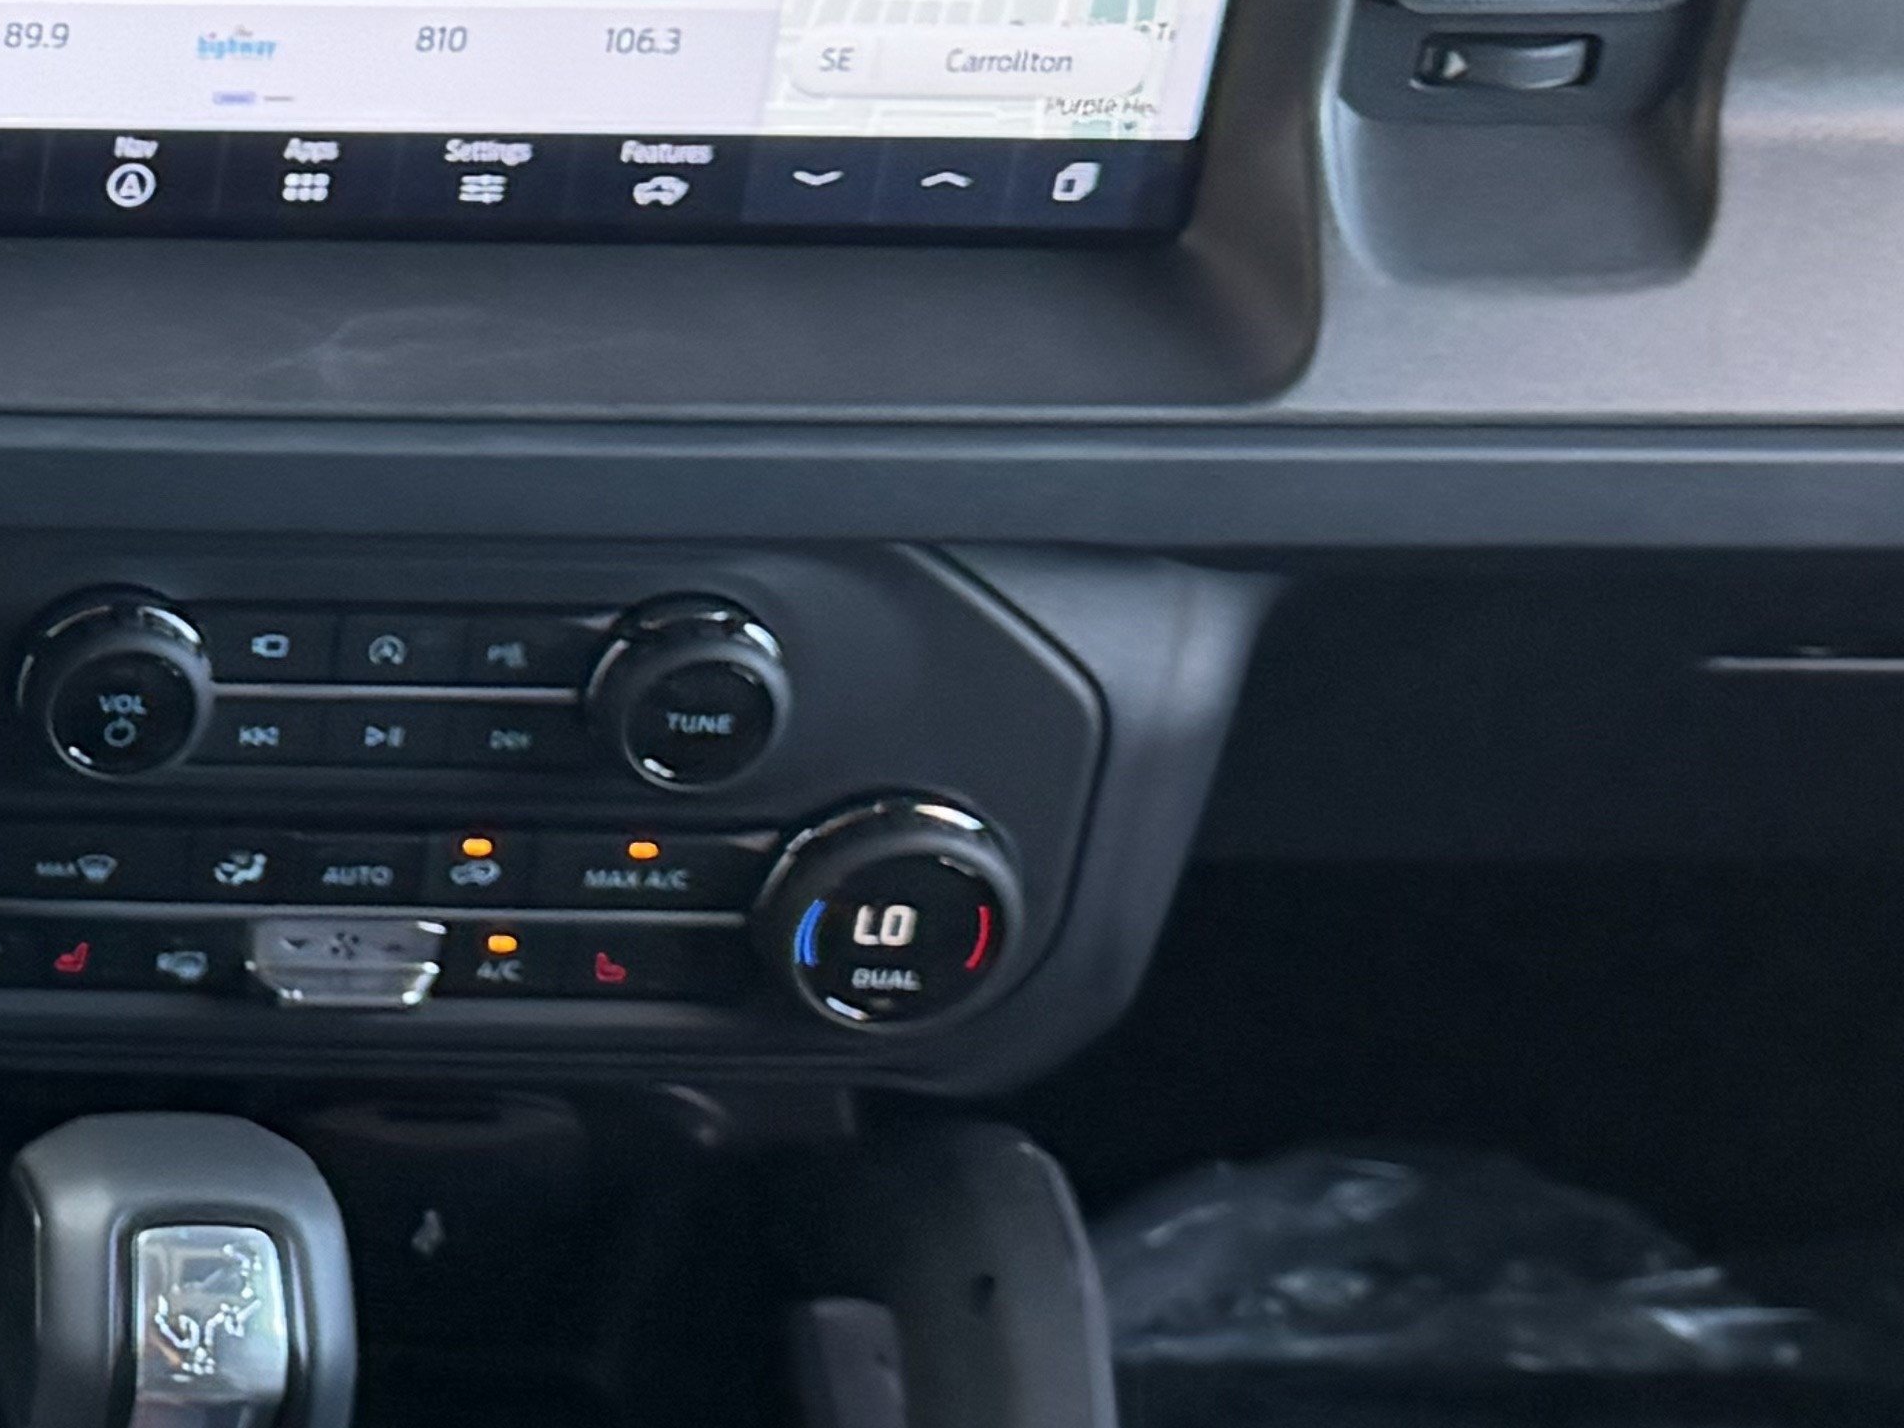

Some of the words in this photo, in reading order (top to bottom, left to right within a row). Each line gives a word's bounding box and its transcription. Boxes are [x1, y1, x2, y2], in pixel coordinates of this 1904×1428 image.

[3, 22, 70, 51] 89.9
[415, 25, 469, 54] 810
[603, 26, 683, 56] 106.3
[819, 46, 855, 73] SE
[944, 47, 1074, 75] Carrollton
[115, 135, 160, 160] Nav
[283, 137, 340, 165] Apps
[445, 138, 534, 169] Settings
[620, 140, 714, 166] Features
[99, 693, 150, 716] VOL
[666, 711, 734, 736] TUNE
[321, 865, 391, 887] AUTO
[583, 868, 640, 890] MAX
[643, 868, 691, 892] A/C
[853, 903, 918, 948] LO
[851, 967, 922, 992] DUAL
